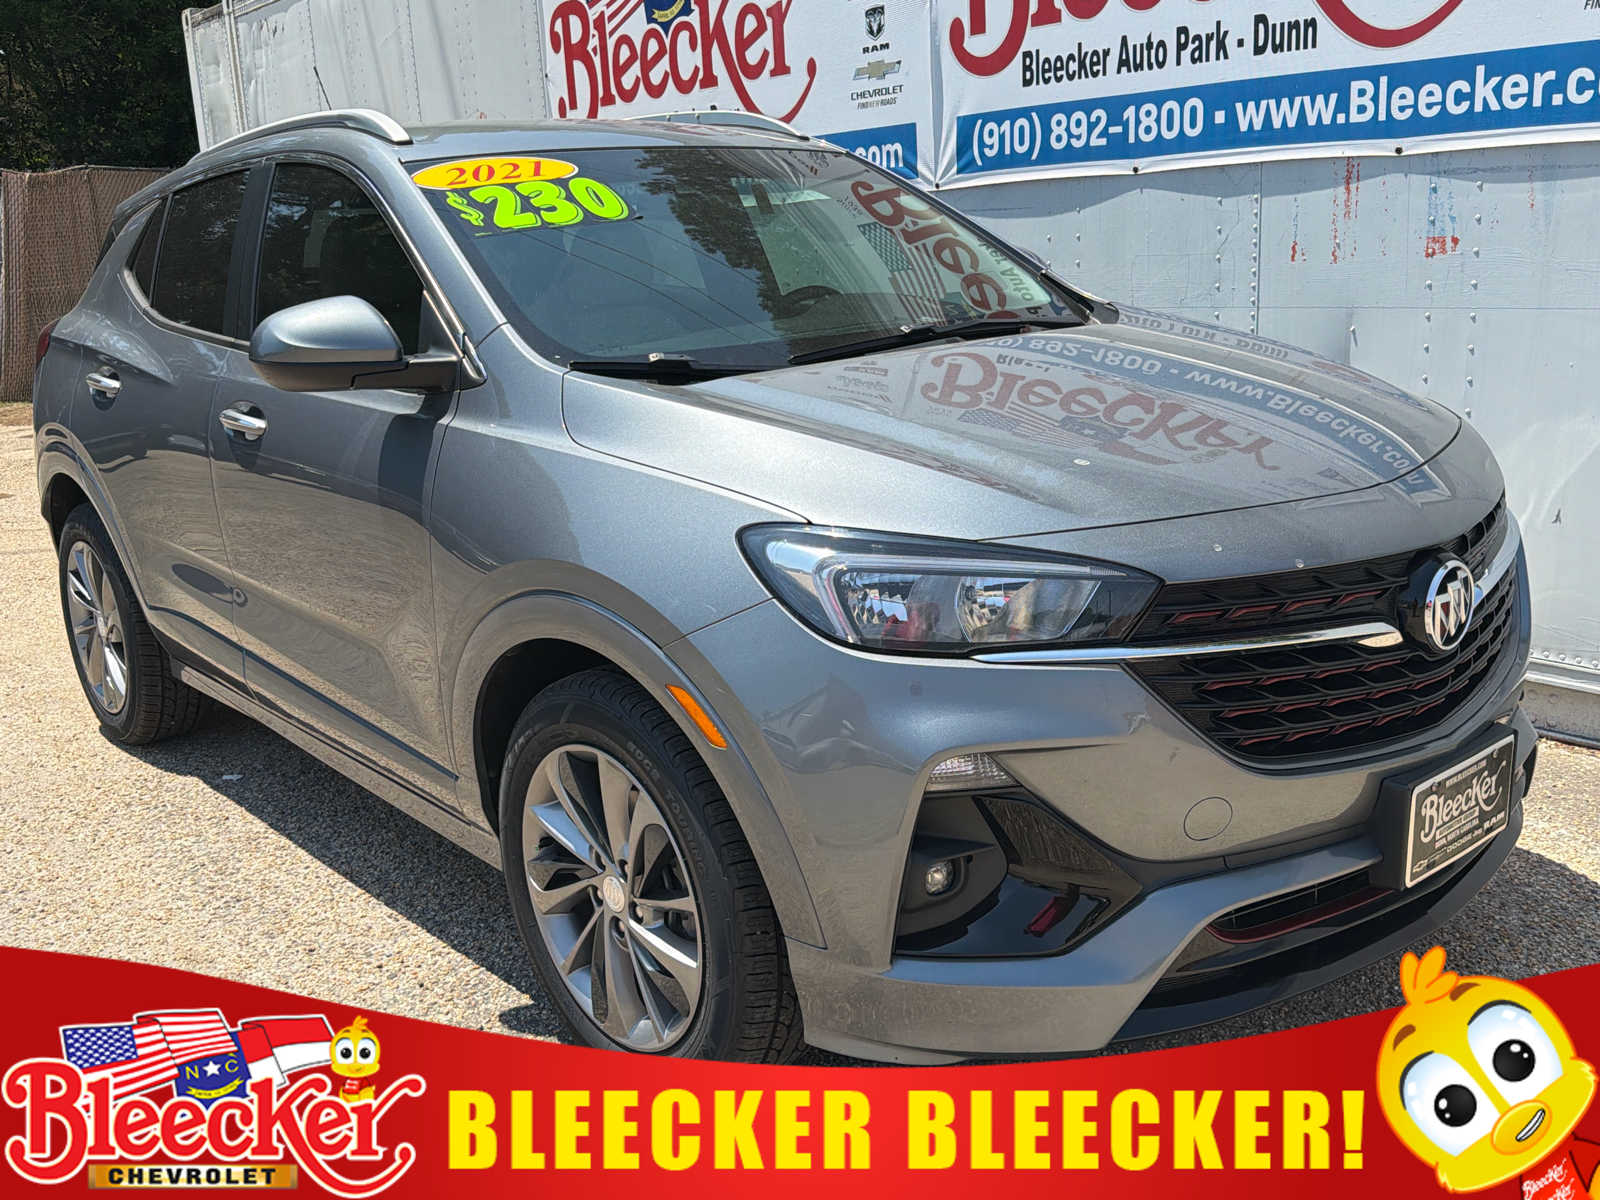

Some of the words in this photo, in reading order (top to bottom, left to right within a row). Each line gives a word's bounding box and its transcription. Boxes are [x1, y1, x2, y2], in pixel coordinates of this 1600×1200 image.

[549, 0, 817, 124] Bleecker
[862, 42, 890, 55] RAM
[1022, 42, 1110, 87] Bleecker
[1116, 32, 1168, 75] Auto
[1175, 20, 1230, 67] Park
[1253, 13, 1318, 56] Dunn
[850, 84, 904, 101] CHEVROLET
[972, 111, 1042, 166] (910)
[1050, 97, 1204, 150] 892-1800
[1235, 63, 1600, 133] www.Bleecker.c
[446, 160, 547, 186] 2021
[446, 178, 630, 230] $230
[1420, 760, 1507, 843] Bleecker
